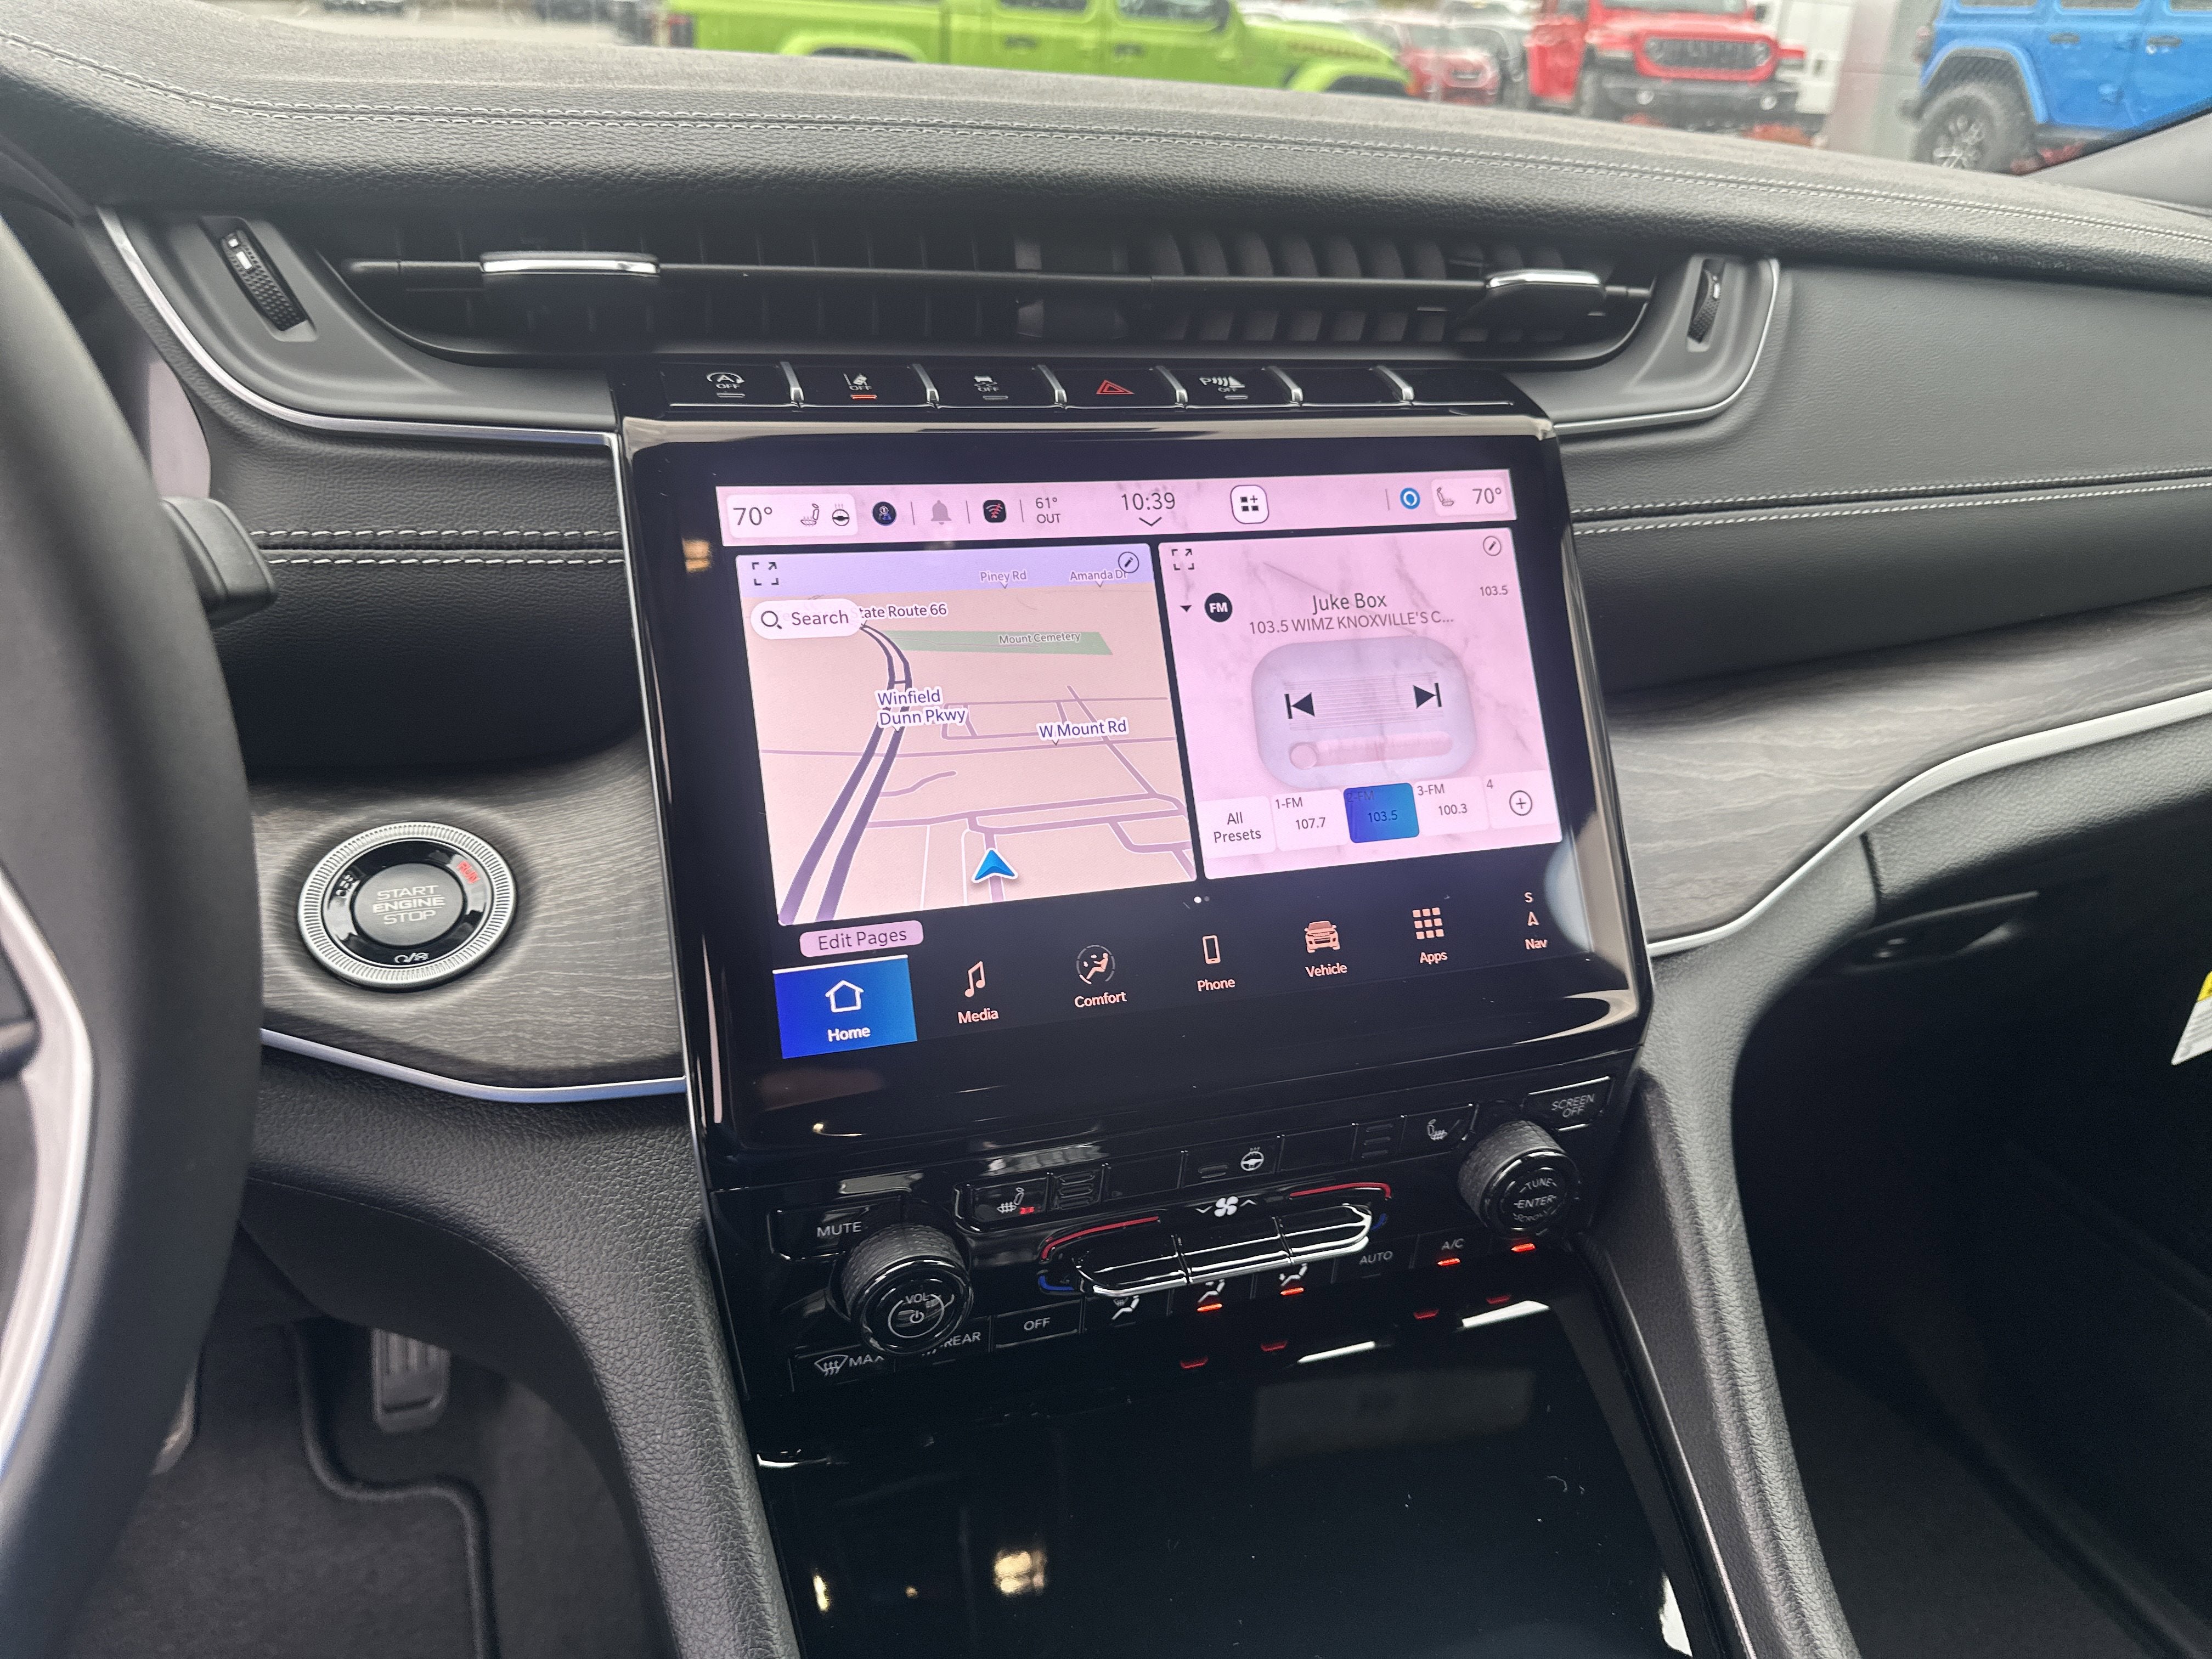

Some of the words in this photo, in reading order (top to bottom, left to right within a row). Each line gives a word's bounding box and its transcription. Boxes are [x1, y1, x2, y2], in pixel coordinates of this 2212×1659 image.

[1035, 497, 1058, 510] 61°
[1121, 492, 1176, 511] 10:39
[1472, 487, 1502, 505] 70°
[733, 506, 772, 527] 70°
[1036, 514, 1061, 524] OUT
[980, 572, 1010, 582] Piney
[1013, 571, 1027, 580] Rd
[1070, 570, 1113, 580] Amanda
[1115, 569, 1127, 579] Dr
[1480, 585, 1508, 597] 103.5
[889, 604, 927, 617] Route
[930, 603, 947, 615] 66
[1210, 602, 1228, 613] FM
[1312, 594, 1350, 615] Juke
[1355, 592, 1387, 608] Box
[791, 609, 849, 626] Search
[1250, 620, 1289, 635] 103.5
[1291, 617, 1335, 632] WIMZ
[1338, 612, 1429, 629] KNOXVILLE'S
[999, 634, 1032, 644] Mount
[1034, 633, 1080, 642] Cemetery
[878, 689, 941, 706] Winfield
[879, 712, 922, 726] Dunn
[926, 709, 966, 724] Pkwy
[1040, 725, 1056, 738] W
[1058, 723, 1103, 737] Mount
[1108, 720, 1127, 734] Rd
[1417, 785, 1445, 796] 3-FM
[1486, 779, 1493, 789] 4
[1275, 797, 1303, 809] 1-FM
[1438, 803, 1468, 816] 100.3
[1227, 812, 1244, 825] All
[1368, 810, 1398, 822] 103.5
[1295, 817, 1326, 831] 107.7
[1213, 827, 1261, 843] Presets
[456, 860, 481, 884] RUN
[377, 885, 439, 900] START
[1524, 892, 1533, 903] S
[373, 896, 445, 913] ENGINE
[383, 910, 436, 925] STOP
[818, 933, 852, 950] Edit
[856, 928, 907, 947] Pages
[1525, 939, 1547, 950] Nav
[1419, 950, 1448, 965] Apps
[1305, 962, 1347, 978] Vehicle
[1197, 977, 1235, 992] Phone
[1074, 991, 1127, 1008] Comfort
[958, 1008, 999, 1024] Media
[827, 1026, 871, 1042] Home
[1551, 1093, 1595, 1111] SCREEN
[1562, 1105, 1584, 1118] OFF
[1525, 1177, 1553, 1190] TUNE
[1516, 1195, 1554, 1209] ENTER
[817, 1221, 862, 1237] MUTE
[1441, 1238, 1465, 1250] A/C
[1359, 1250, 1393, 1265] AUTO
[905, 1293, 929, 1304] VOL
[1024, 1317, 1051, 1331] OFF
